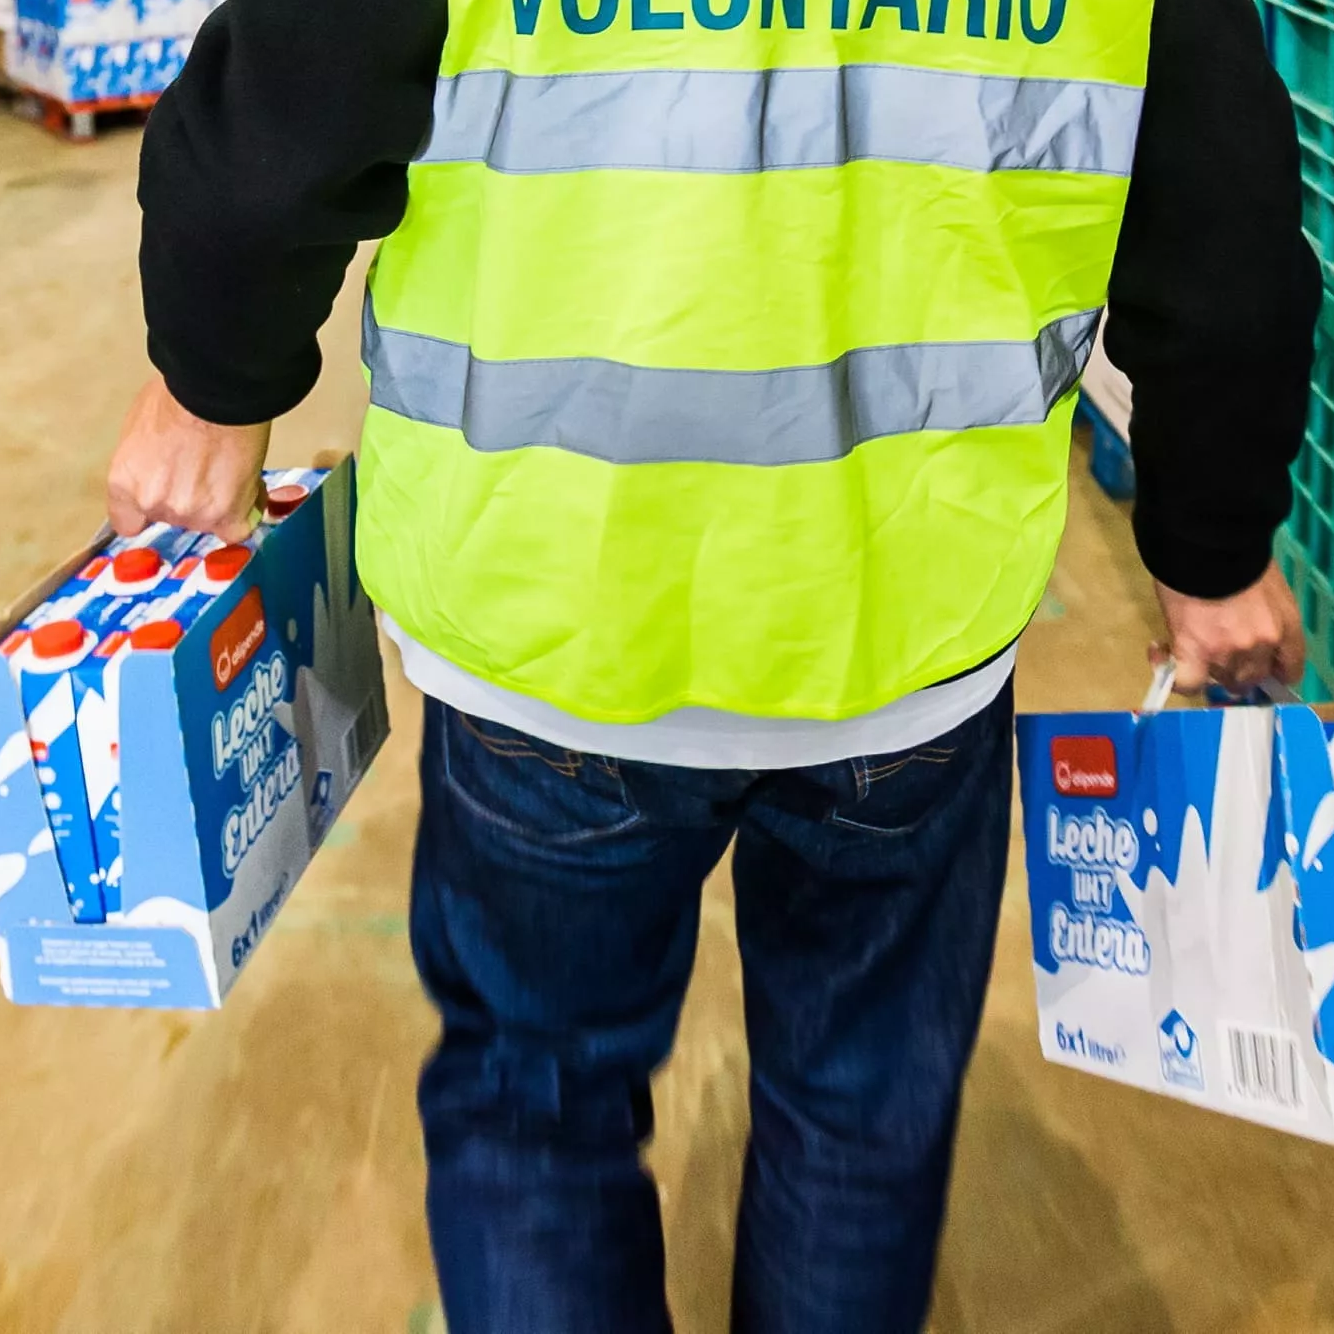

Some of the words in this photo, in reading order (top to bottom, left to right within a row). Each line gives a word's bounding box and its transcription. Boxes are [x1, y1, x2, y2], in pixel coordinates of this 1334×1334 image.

[213, 654, 285, 775] Leche
[223, 741, 301, 873] Entera
[1048, 808, 1137, 871] Leche
[1051, 906, 1149, 974] Entera
